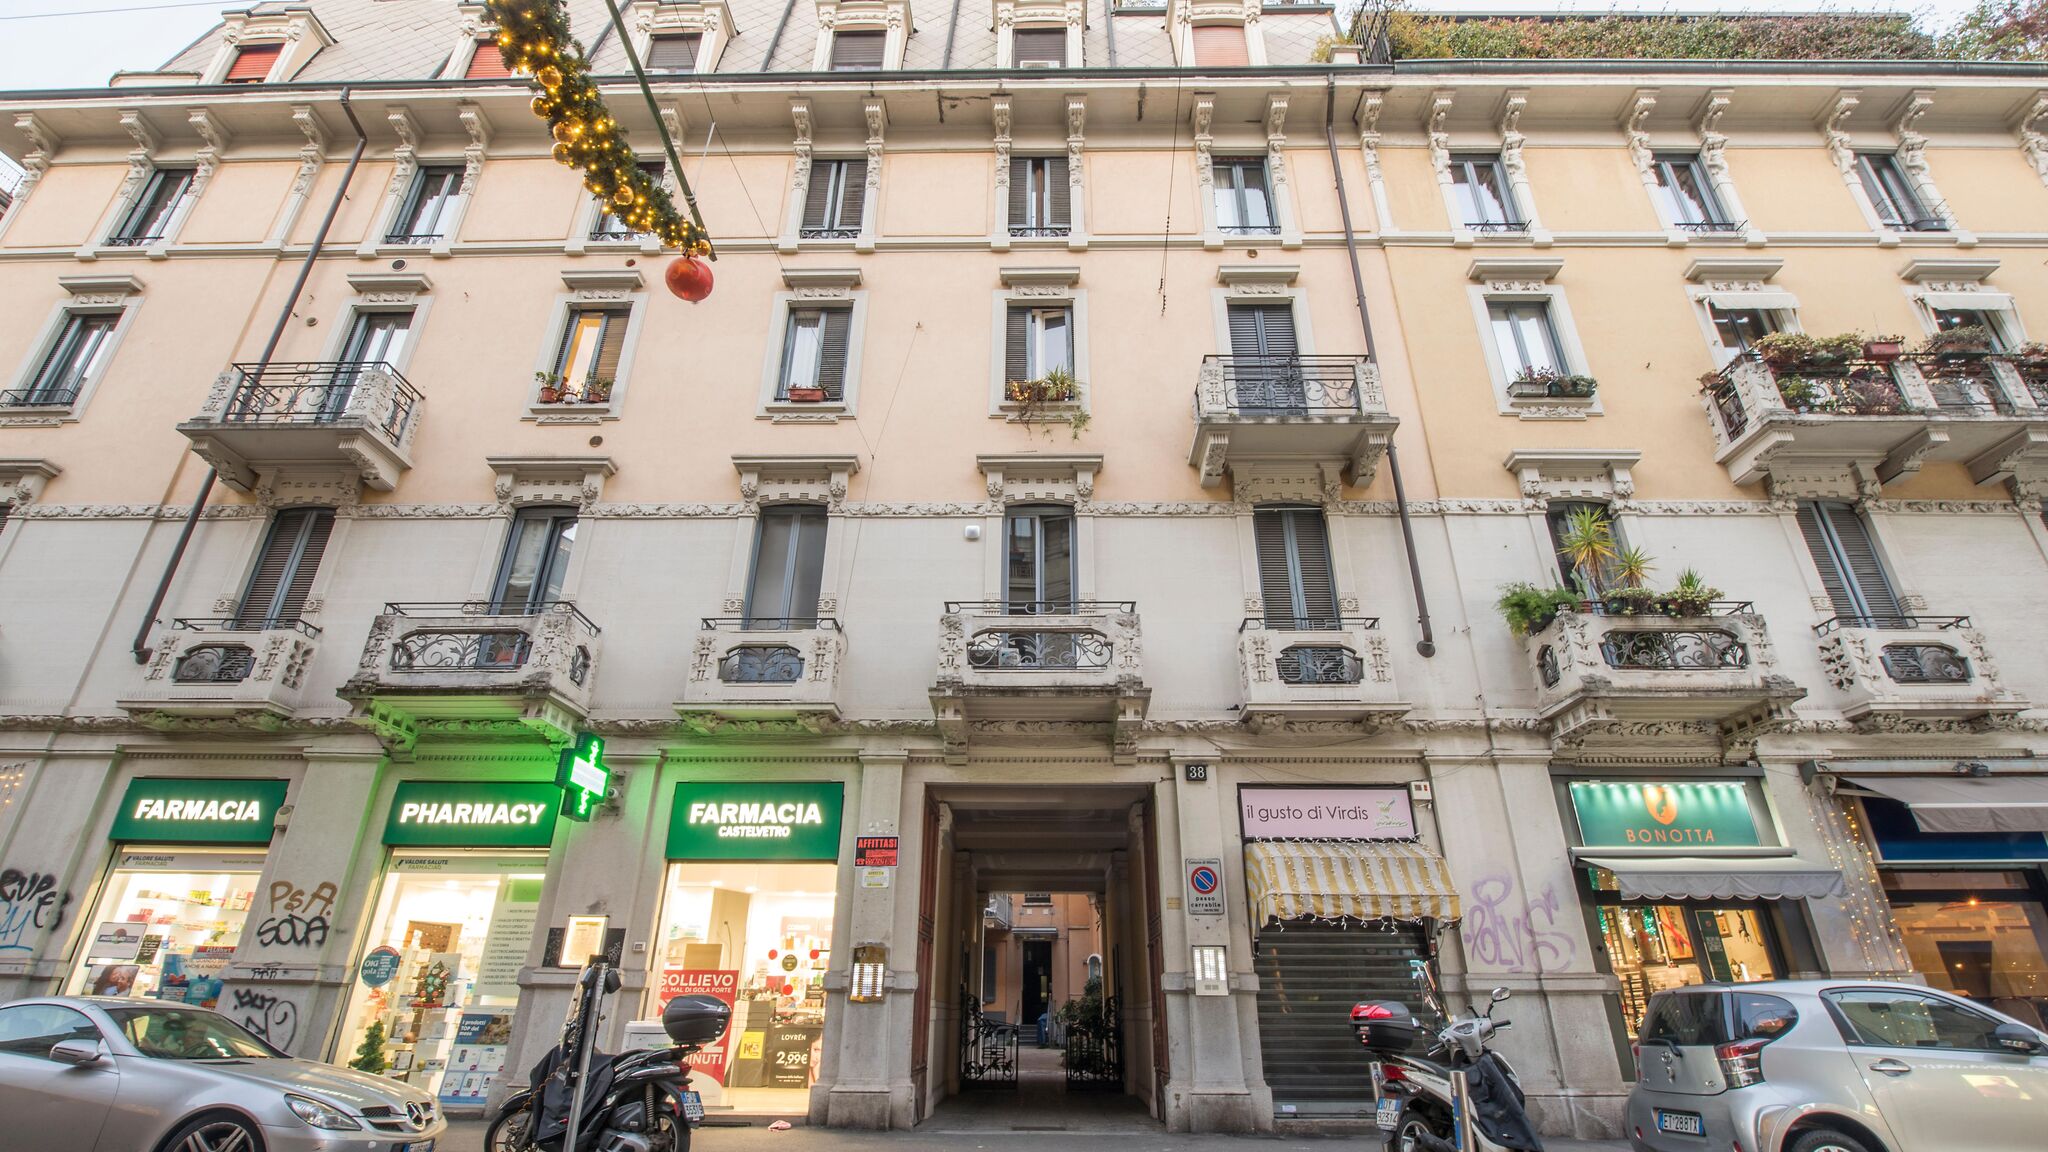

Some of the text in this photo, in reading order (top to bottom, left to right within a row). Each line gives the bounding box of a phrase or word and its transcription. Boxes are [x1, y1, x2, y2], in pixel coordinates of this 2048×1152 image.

[1190, 766, 1205, 778] 38
[134, 799, 260, 821] FARMACIA
[400, 803, 546, 824] PHARMACY
[689, 803, 822, 824] FARMACIA
[1246, 804, 1369, 823] il gusto di Virdis
[718, 825, 791, 838] CASTELVETRO
[1625, 828, 1714, 843] BONOTTA
[857, 838, 897, 849] AFFITTASI
[661, 974, 734, 987] SOLLIEVO
[775, 1051, 808, 1066] 2,99€
